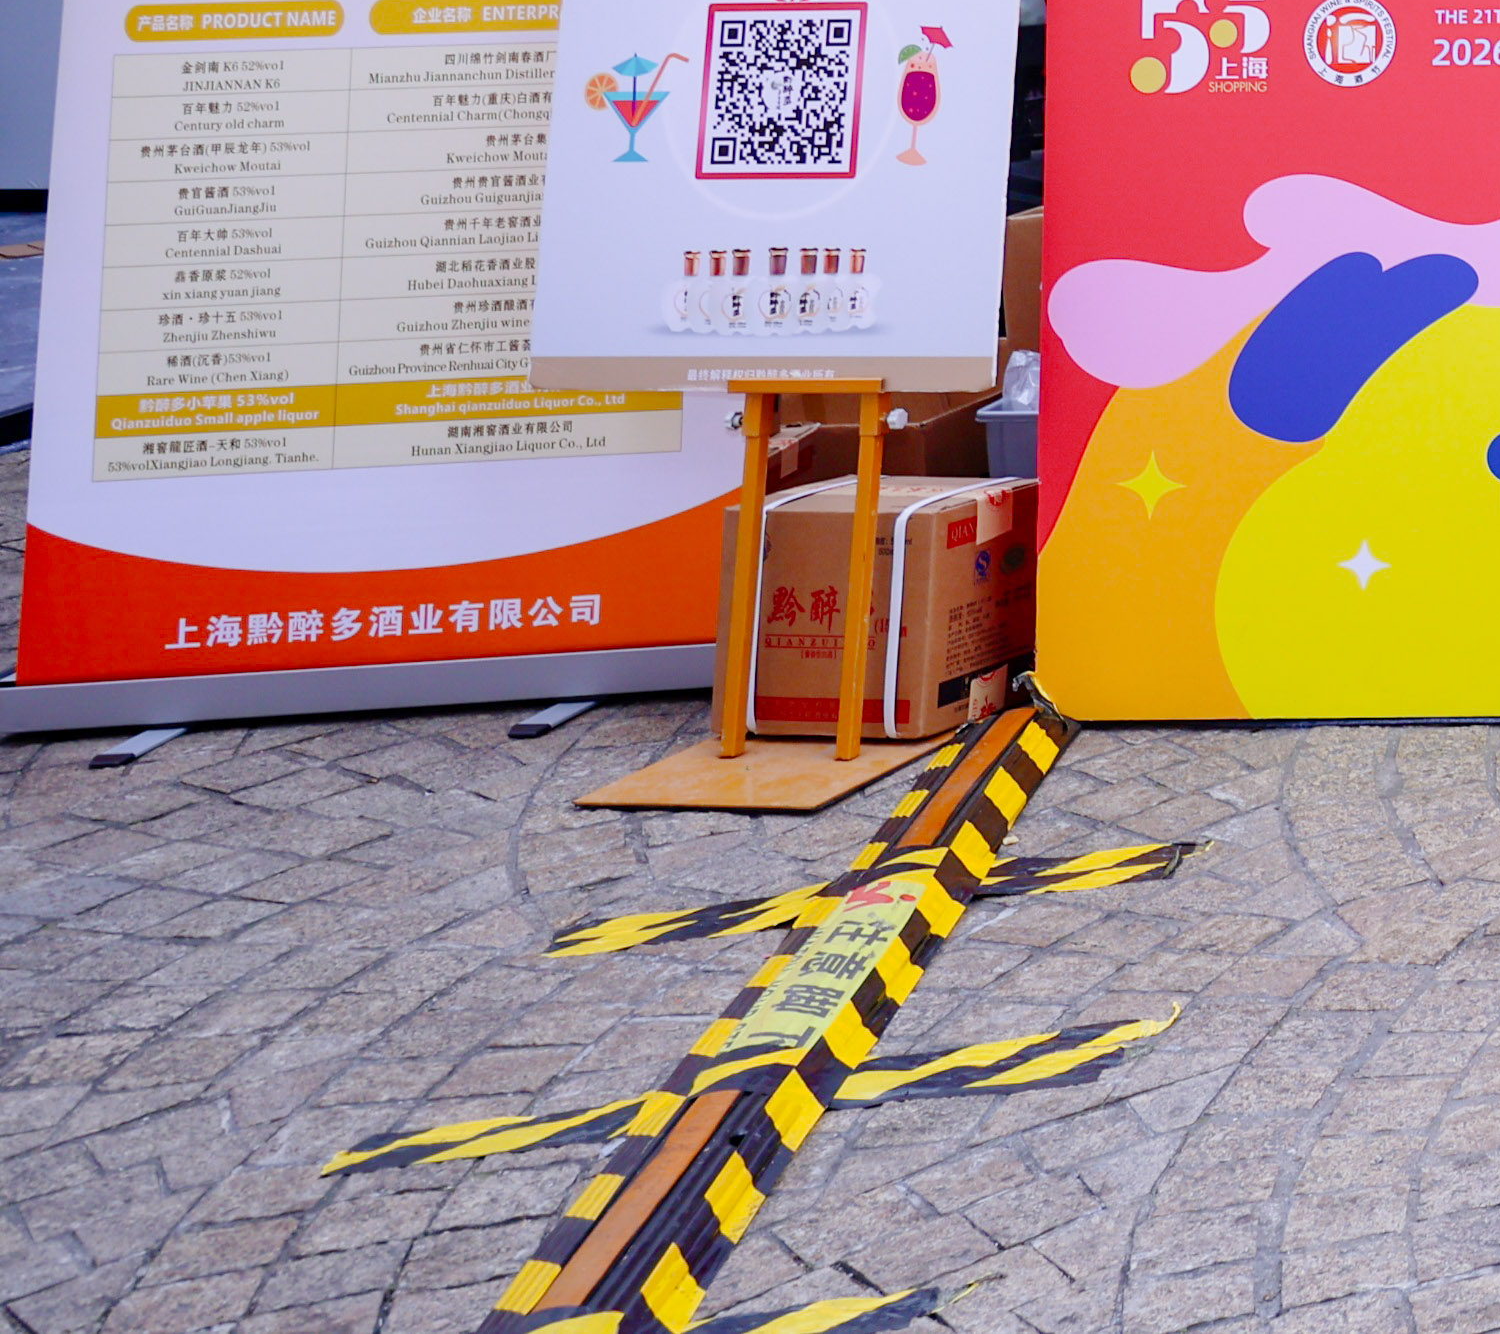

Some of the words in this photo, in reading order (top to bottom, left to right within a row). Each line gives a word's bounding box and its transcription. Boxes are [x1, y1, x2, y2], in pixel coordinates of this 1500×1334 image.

[137, 15, 194, 32] 产品名称
[202, 12, 283, 30] PRODUCT
[286, 10, 337, 27] NAME
[412, 7, 473, 24] 企业名称
[1435, 9, 1468, 24] THE
[181, 61, 220, 74] 金剑南
[223, 62, 239, 72] K6
[242, 60, 285, 72] 52%vol
[1215, 56, 1269, 80] 上海
[369, 73, 421, 85] Mianzhu
[423, 70, 502, 83] Jiannanchun
[182, 80, 261, 92] JINJIANNAN
[265, 79, 281, 90] K6
[1208, 82, 1268, 93] SHOPPING
[182, 101, 233, 116] 百年魅力
[236, 101, 280, 112] 52%vol
[387, 110, 454, 124] Centennial
[174, 119, 223, 135] Century
[225, 117, 244, 131] old
[248, 116, 286, 130] charm
[140, 141, 267, 159] 贵州茅台酒(甲辰龙年)
[270, 140, 311, 152] 53%vol
[446, 153, 510, 164] Kweichow
[174, 163, 236, 175] Kweichow
[240, 160, 281, 172] Moutai
[178, 186, 229, 200] 贵官酱酒
[232, 186, 276, 197] 53%vol
[420, 194, 472, 206] Guizhou
[174, 203, 277, 217] GuiGuanJiangJiu
[177, 229, 228, 243] 百年大帅
[231, 228, 273, 239] 53%vol
[365, 237, 417, 249] Guizhou
[420, 235, 475, 248] Qiannian
[479, 233, 525, 246] Laojiao
[165, 246, 231, 259] Centennial
[234, 243, 282, 256] Dashuai
[230, 268, 271, 280] 52%vol
[407, 279, 444, 291] Hubei
[447, 276, 528, 290] Daohuaxiang
[162, 289, 181, 300] xin
[185, 287, 218, 302] xiang
[220, 288, 248, 301] yuan
[251, 285, 281, 298] jiang
[240, 310, 283, 321] 53%vol
[397, 321, 448, 333] Guizhou
[451, 318, 497, 331] Zhenjiu
[501, 318, 530, 328] wine
[162, 331, 208, 345] Zhenjiu
[211, 327, 277, 341] Zhenshiwu
[349, 364, 396, 376] Guizhou
[398, 362, 447, 374] Province
[449, 360, 494, 372] Renhuai
[495, 358, 518, 371] City
[147, 374, 175, 386] Rare
[178, 372, 208, 384] Wine
[211, 371, 247, 385] (Chen
[250, 369, 289, 383] Xiang)
[138, 394, 232, 414] 黔醉多小苹果
[236, 392, 295, 407] 53%vol
[395, 402, 456, 416] Shanghai
[459, 399, 531, 416] qianzuiduo
[534, 396, 574, 409] Liquor
[605, 393, 626, 405] Ltd
[111, 416, 192, 431] Qianzuiduo
[195, 412, 234, 426] Small
[237, 412, 274, 426] apple
[277, 409, 320, 424] liquor
[447, 420, 574, 438] 湖南湘窖酒业有限公司
[244, 437, 287, 448] 53%vol
[411, 444, 451, 456] Hunan
[455, 441, 513, 456] Xiangjiao
[516, 439, 555, 454] Liquor
[586, 436, 606, 448] Ltd
[108, 457, 207, 473] 53%volXiangjiao
[164, 592, 602, 651] 上海黔醉多酒业有限公司
